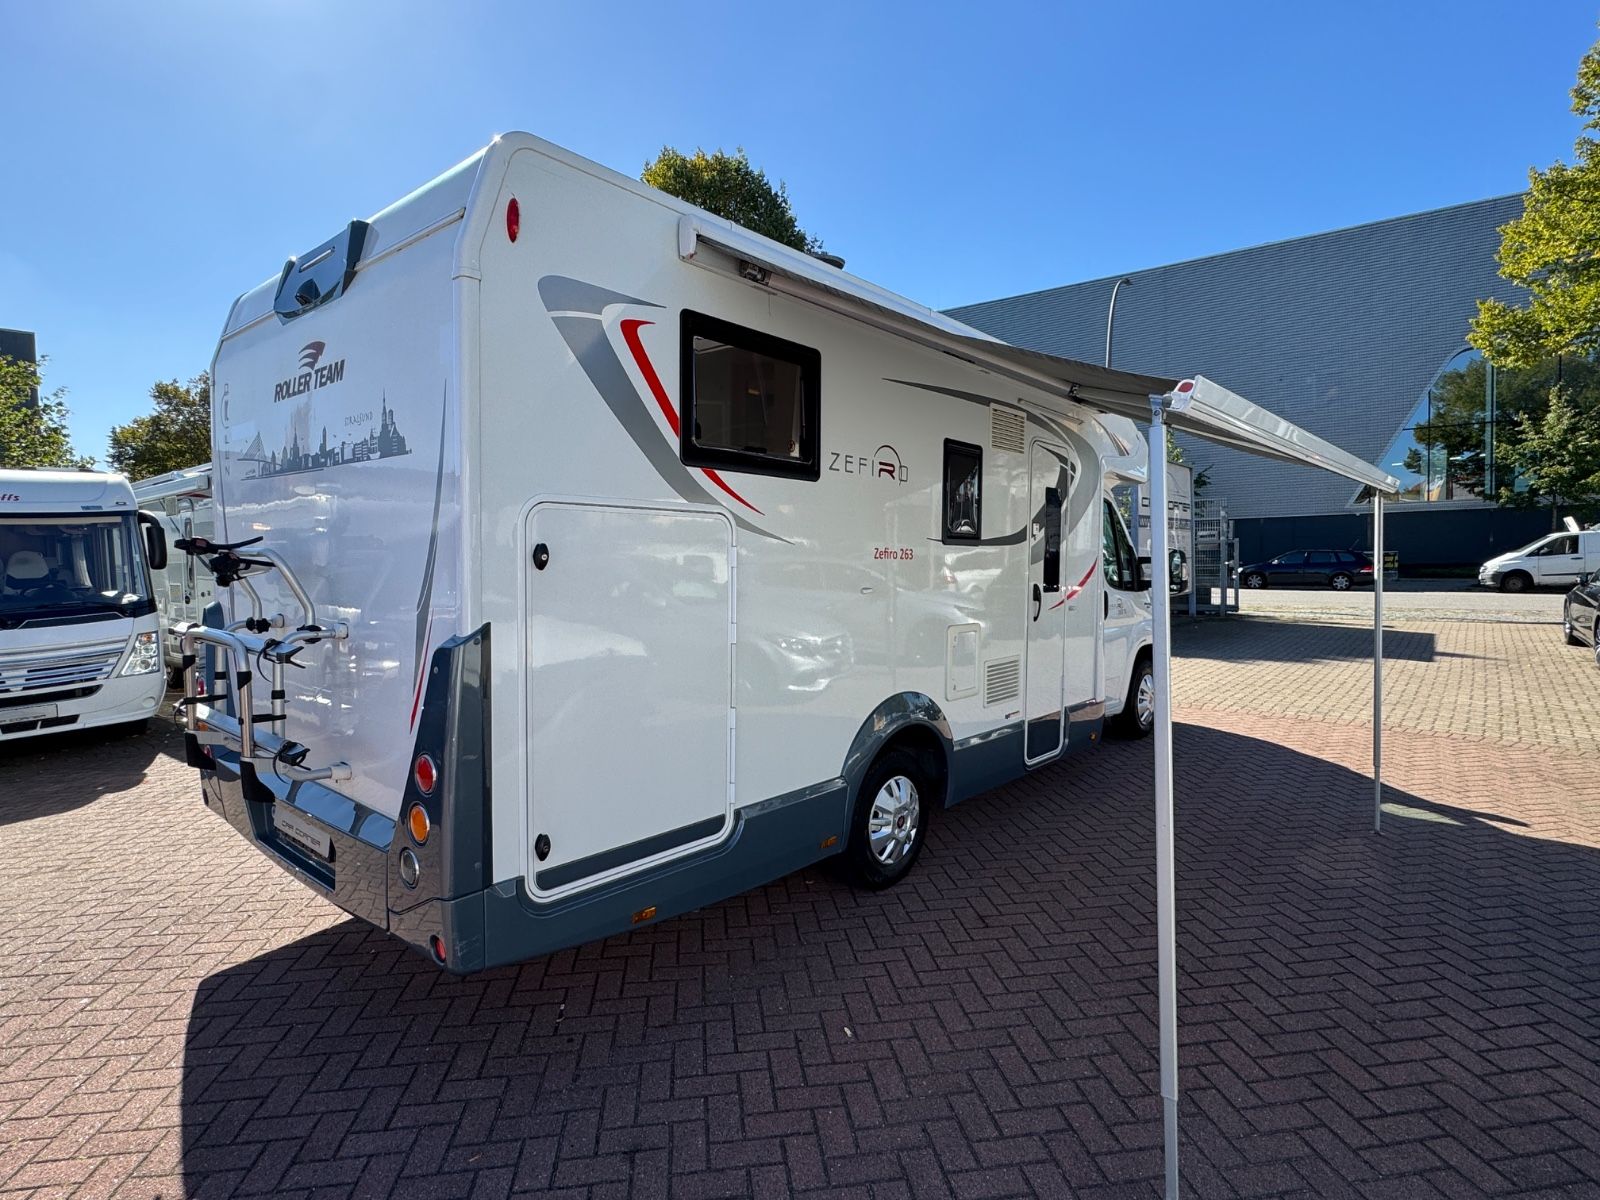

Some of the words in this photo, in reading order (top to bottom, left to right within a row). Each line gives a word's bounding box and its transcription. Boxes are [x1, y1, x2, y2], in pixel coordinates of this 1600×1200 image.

[274, 371, 312, 403] ROLLER
[314, 359, 345, 389] TEAM
[874, 547, 898, 560] Zefiro
[900, 548, 914, 560] 263
